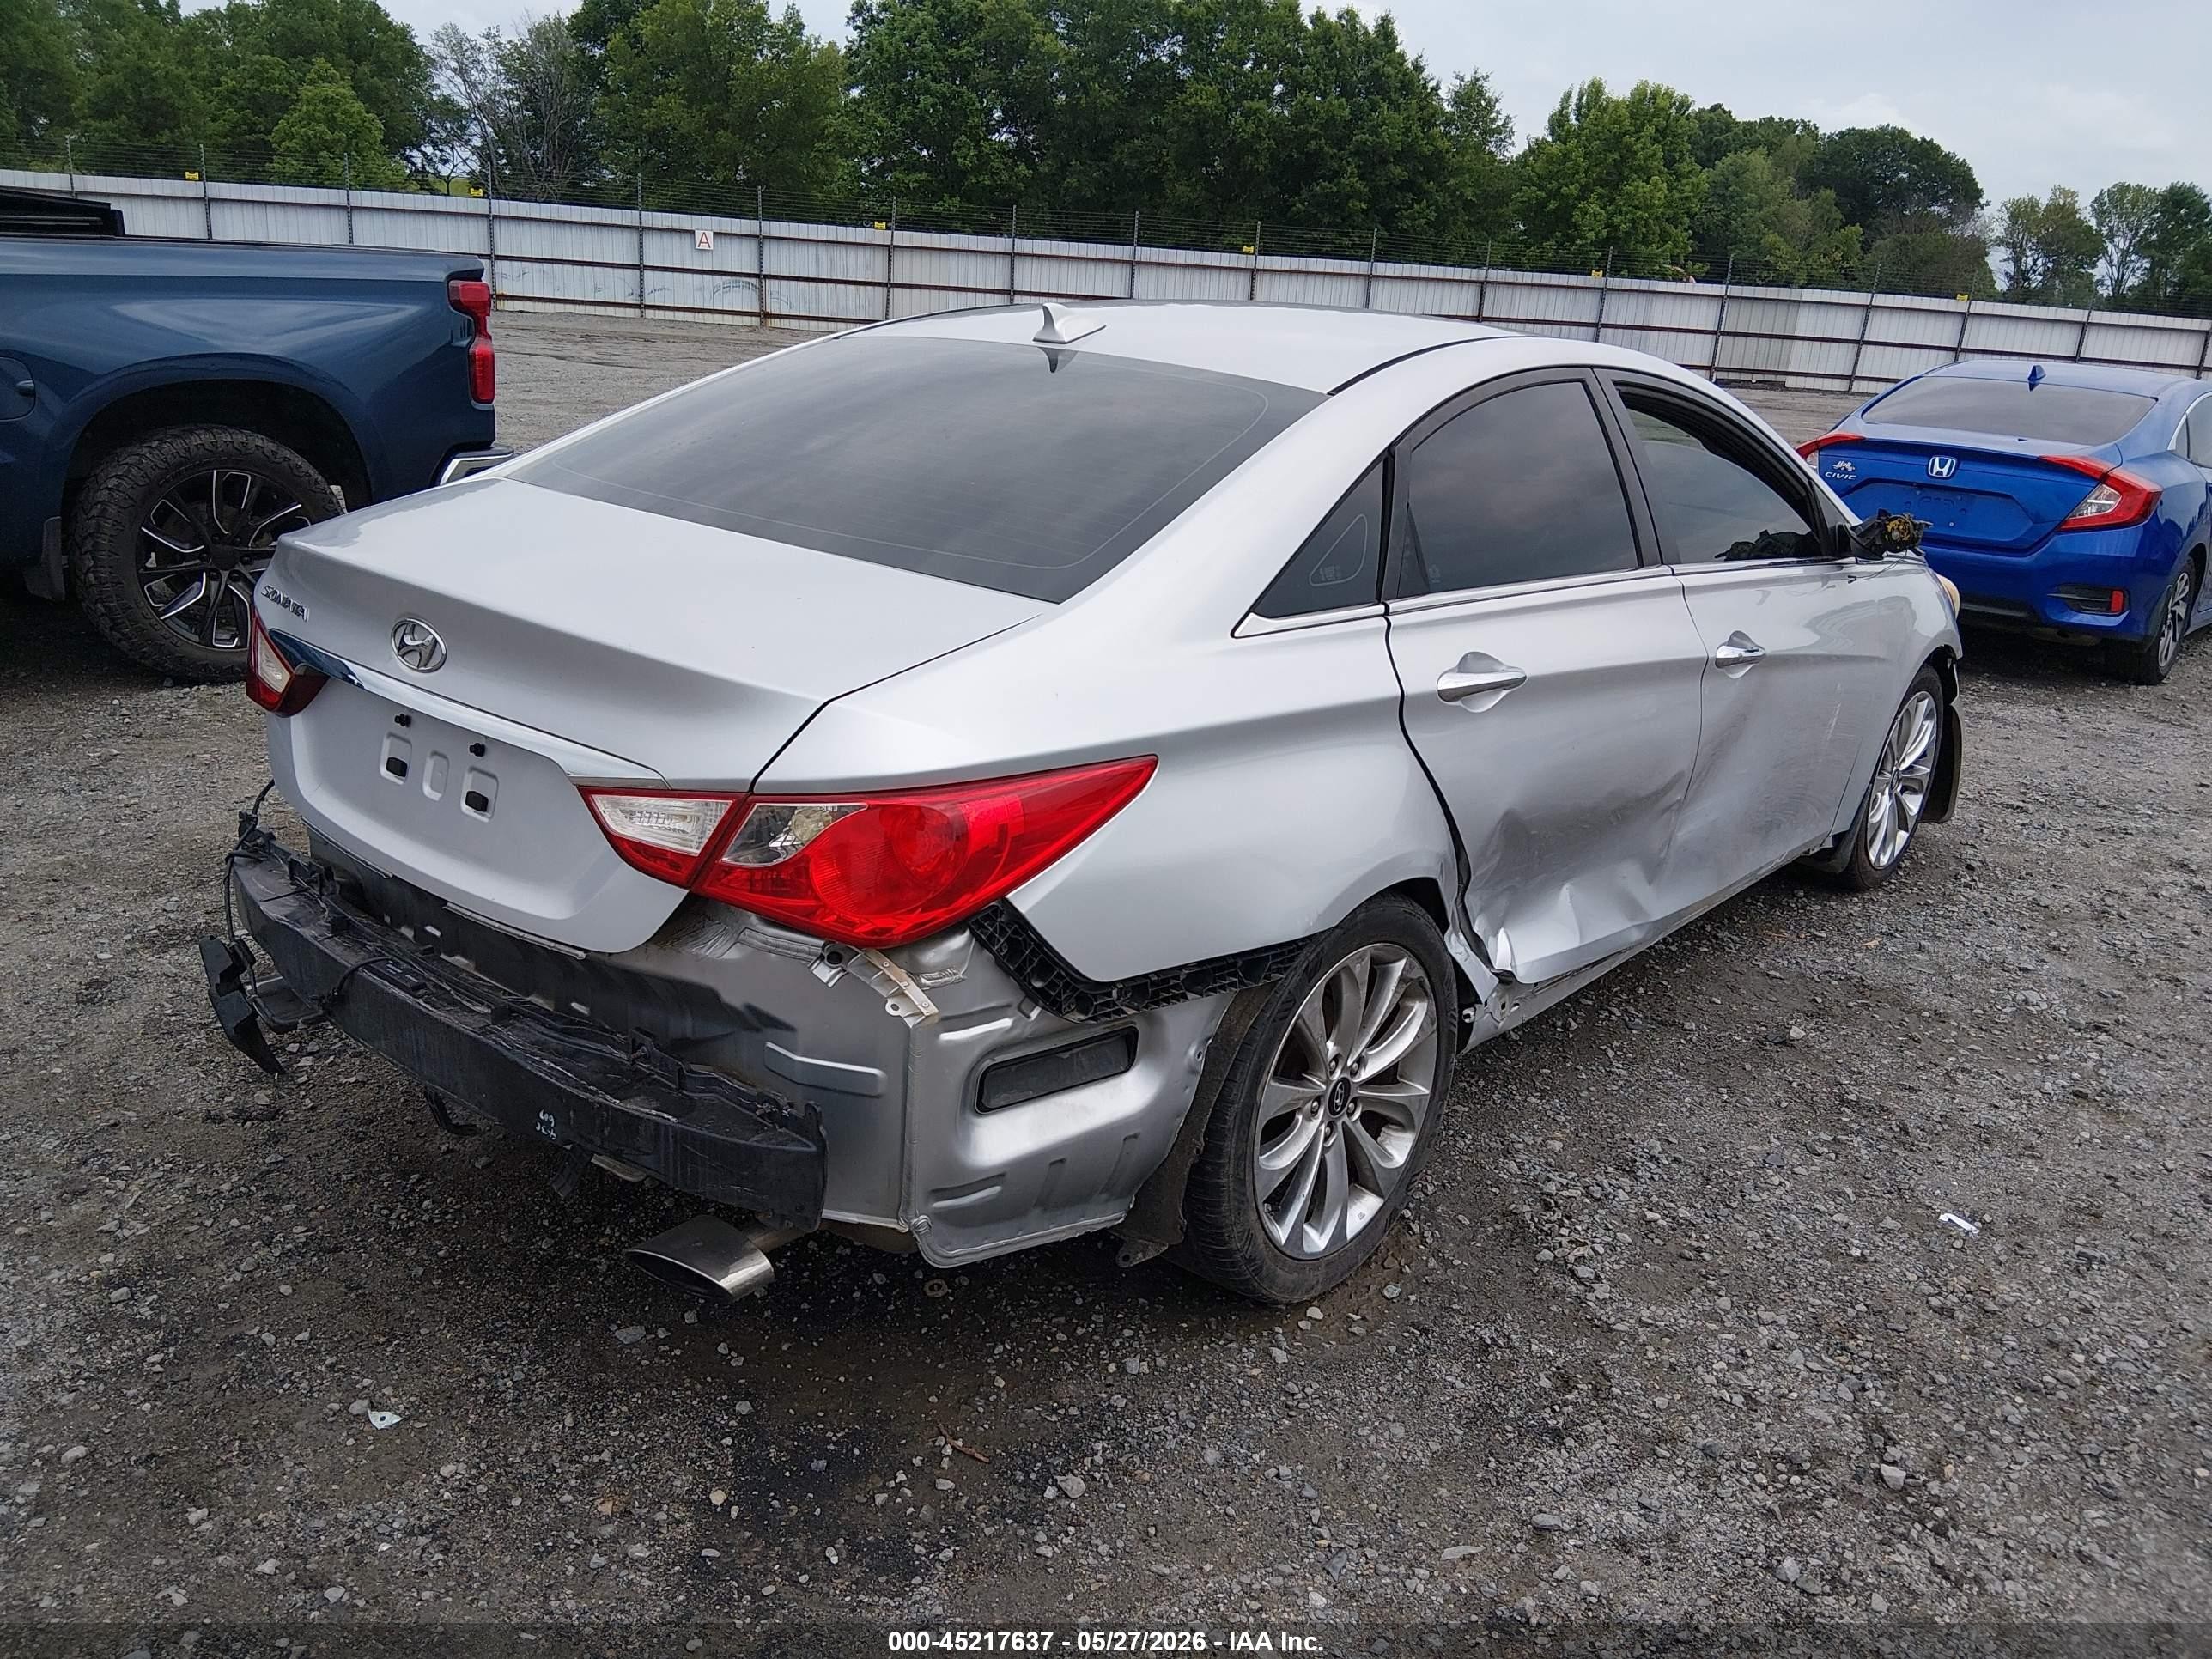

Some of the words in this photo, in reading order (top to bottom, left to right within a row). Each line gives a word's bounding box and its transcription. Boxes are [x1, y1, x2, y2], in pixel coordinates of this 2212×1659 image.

[697, 231, 711, 249] A
[1825, 471, 1857, 480] CIVIC
[260, 585, 310, 623] SONATA
